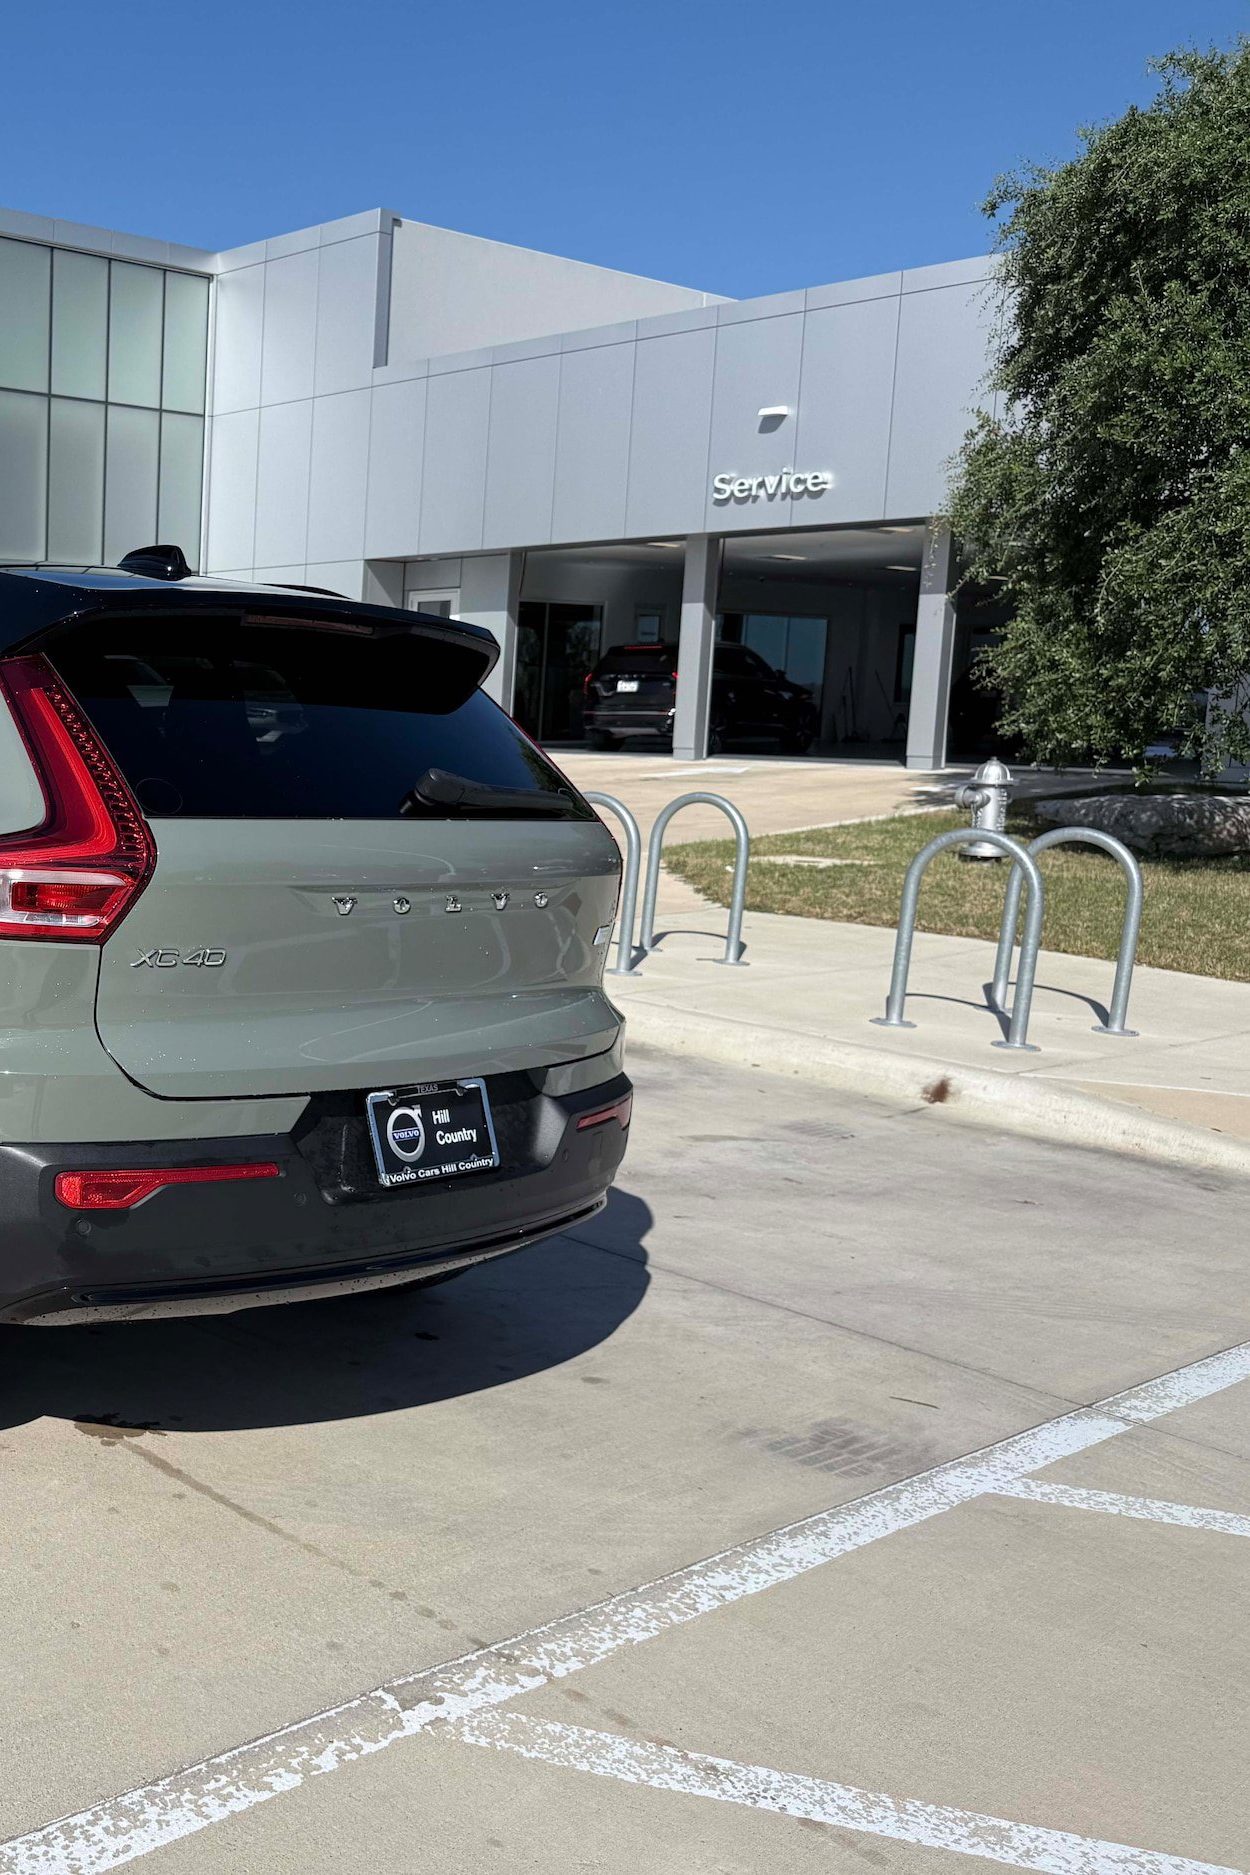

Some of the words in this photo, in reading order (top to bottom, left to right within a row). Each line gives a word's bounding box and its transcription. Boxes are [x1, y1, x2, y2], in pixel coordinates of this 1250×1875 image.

[712, 467, 832, 499] Service
[332, 892, 549, 915] VOLVO
[416, 1083, 439, 1094] TEXAS
[432, 1109, 450, 1124] Hill
[392, 1130, 420, 1140] VOLVO
[436, 1128, 477, 1145] Country
[390, 1171, 417, 1183] Volvo
[418, 1168, 440, 1178] Cars
[441, 1163, 458, 1174] Hill
[458, 1158, 494, 1171] Country
